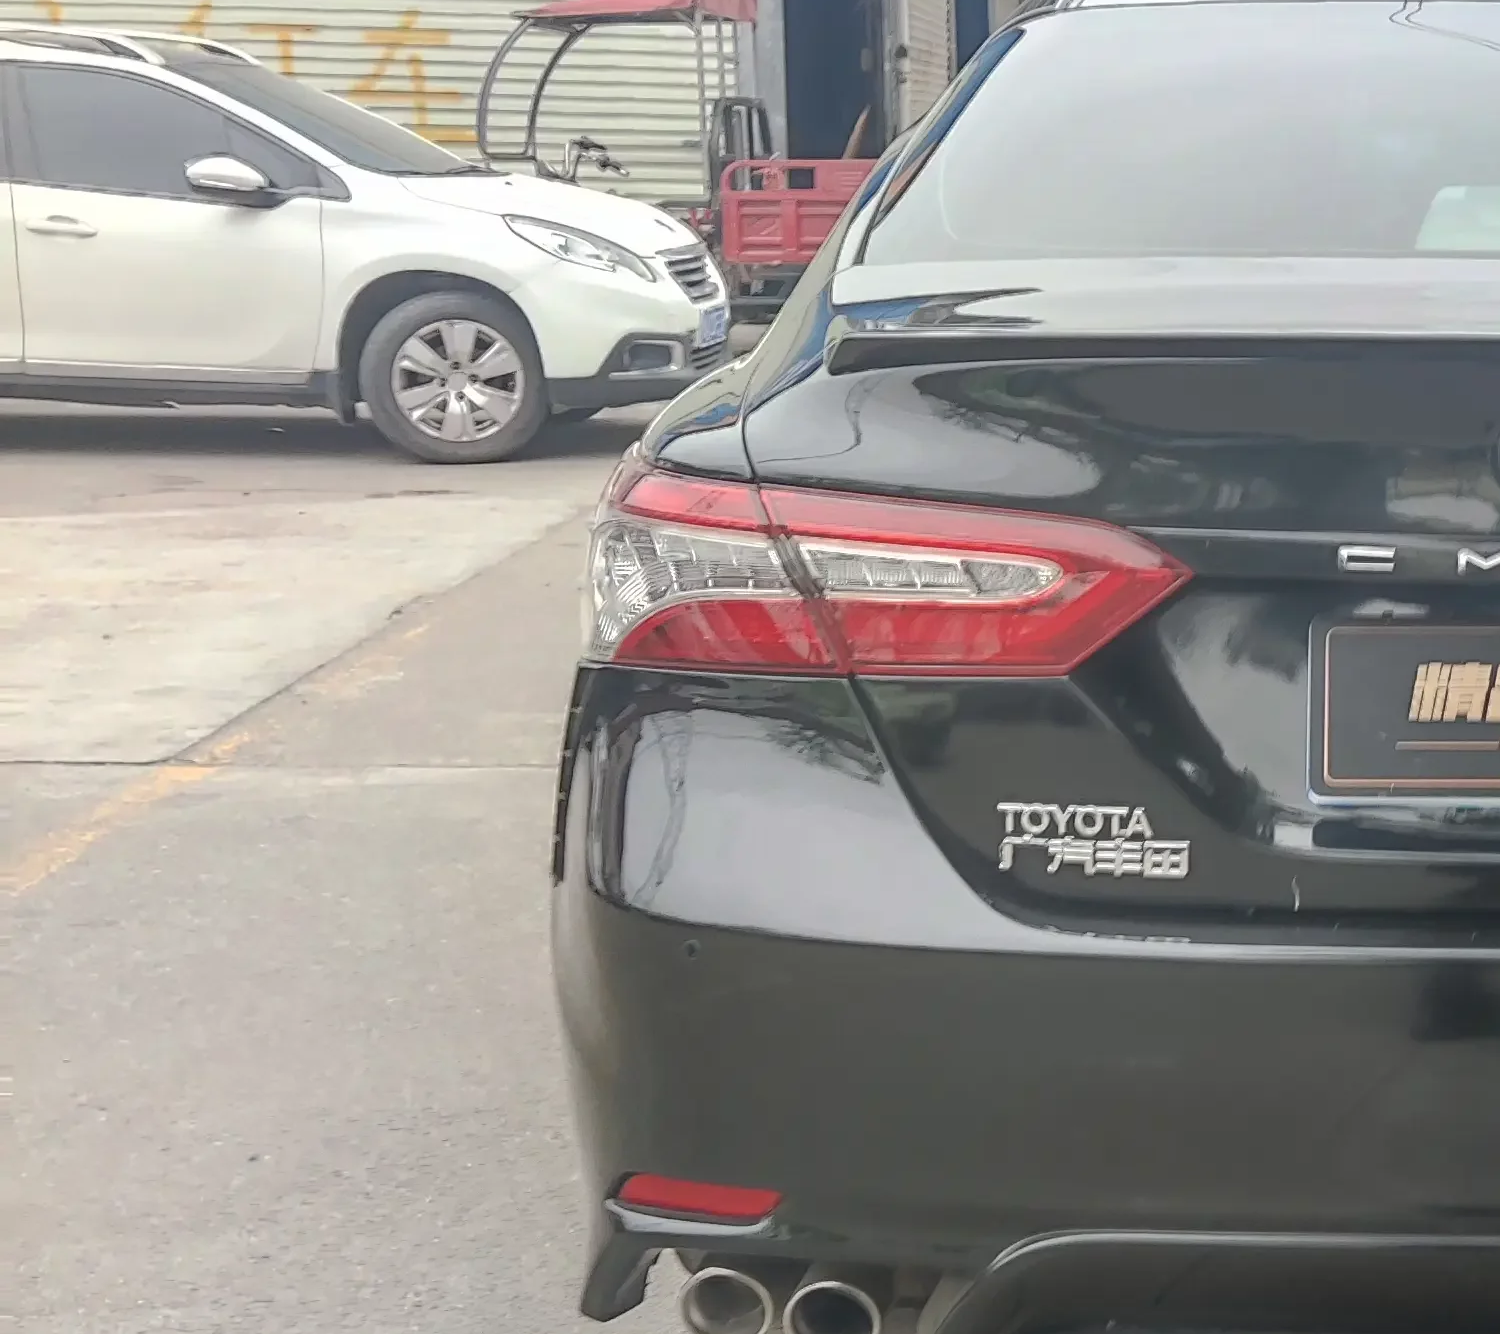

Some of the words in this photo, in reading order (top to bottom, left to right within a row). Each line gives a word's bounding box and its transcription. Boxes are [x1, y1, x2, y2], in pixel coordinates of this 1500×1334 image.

[997, 802, 1154, 839] TOYOTA
[998, 833, 1191, 879] 广汽丰田
